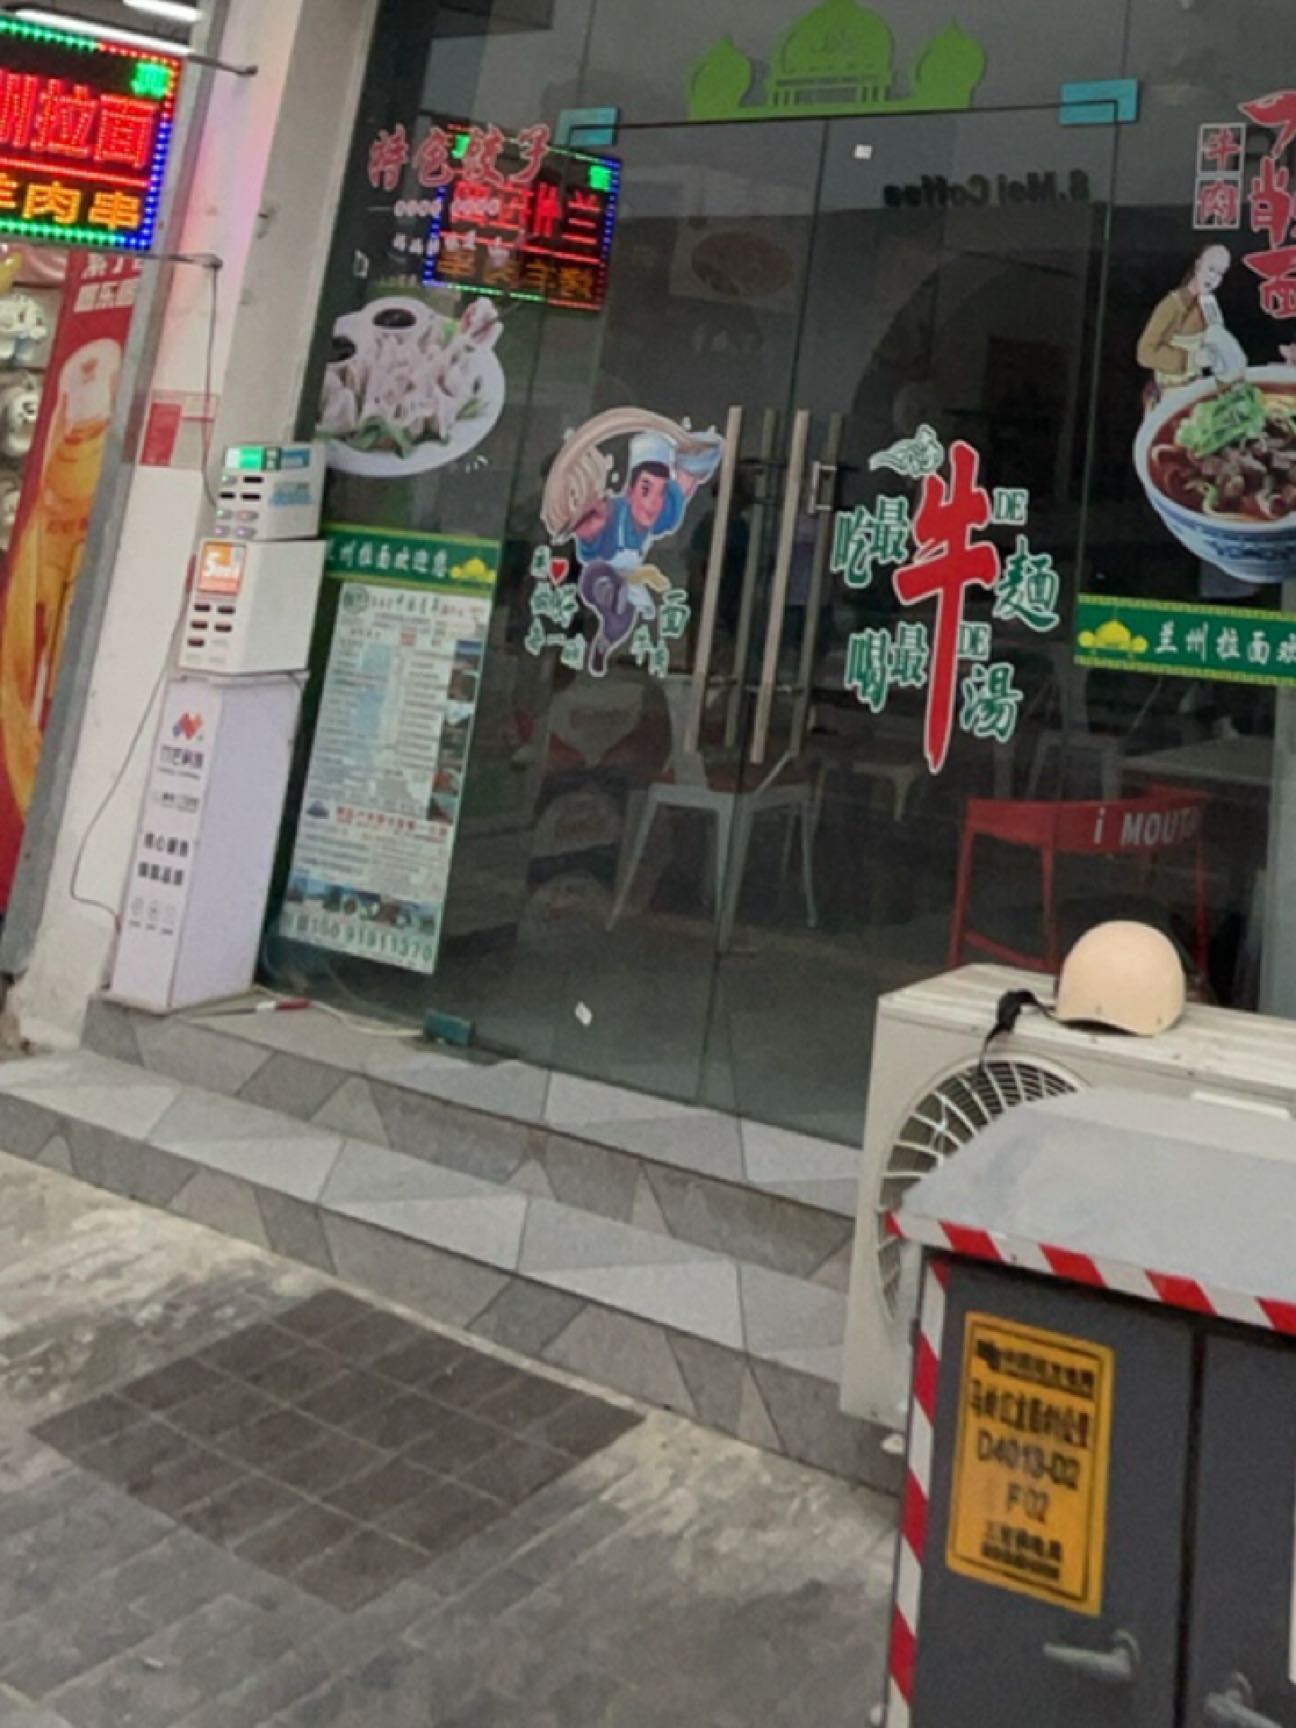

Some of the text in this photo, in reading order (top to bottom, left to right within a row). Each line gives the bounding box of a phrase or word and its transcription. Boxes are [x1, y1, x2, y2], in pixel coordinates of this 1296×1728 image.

[1198, 126, 1241, 227] 牛肉
[993, 489, 1028, 525] DE
[894, 440, 1001, 775] 牛
